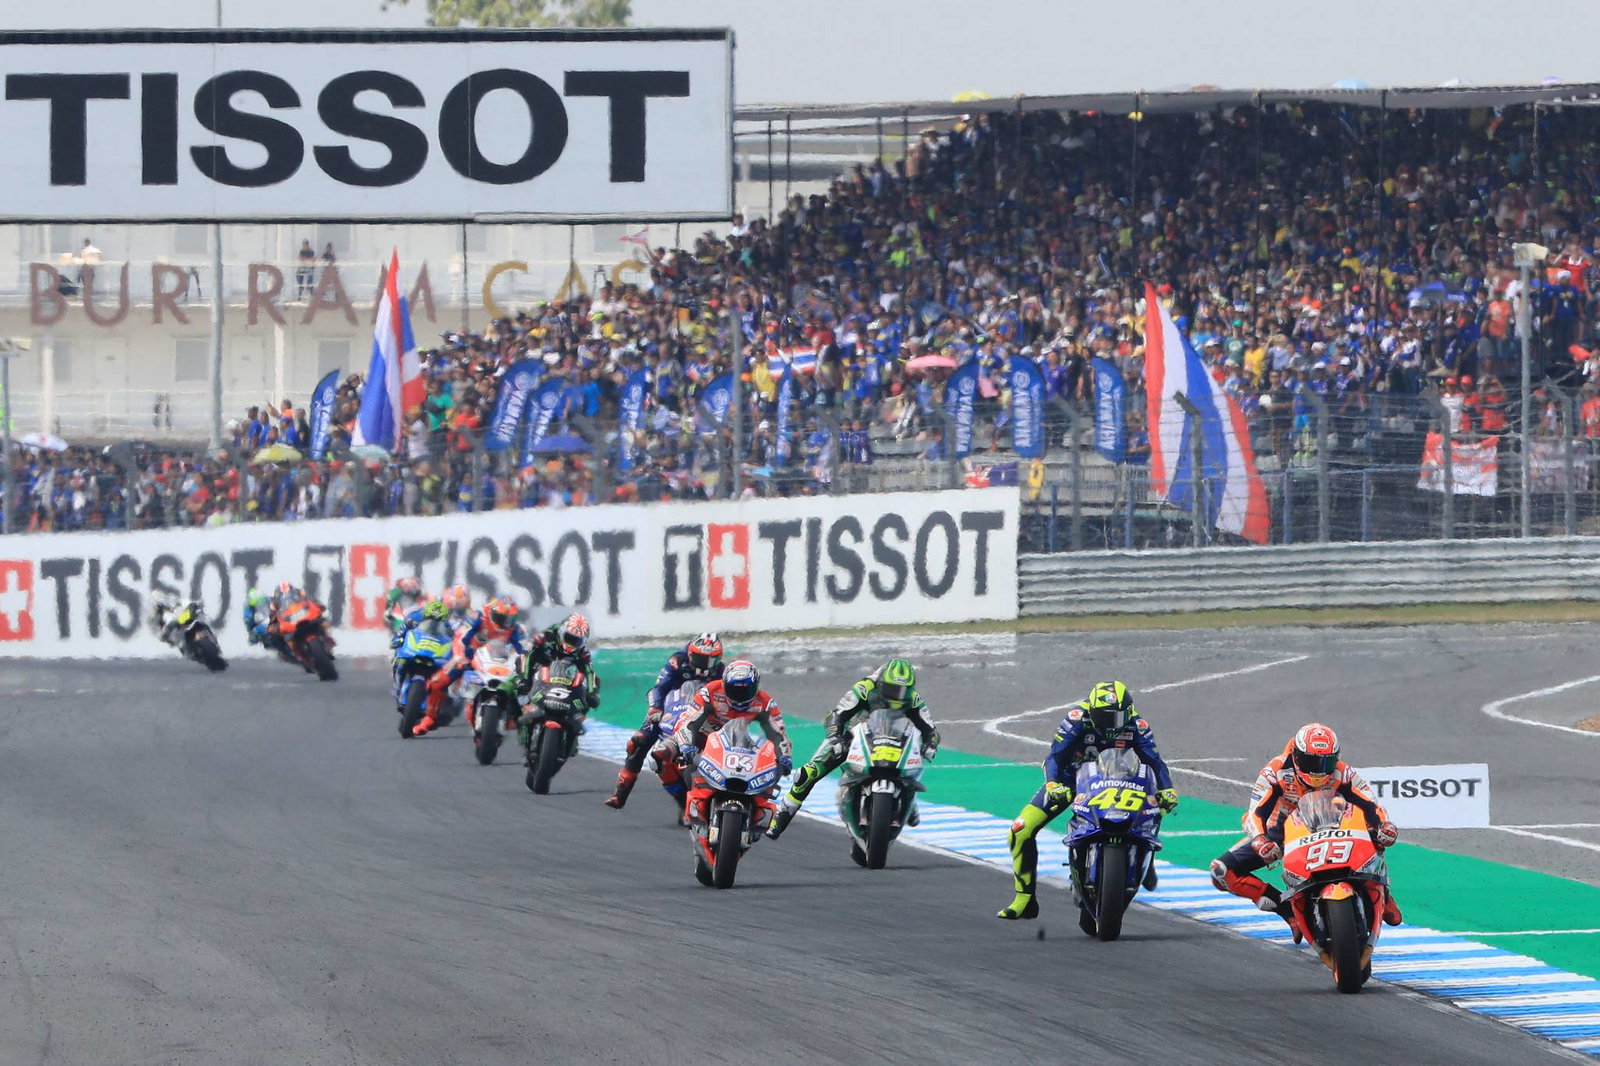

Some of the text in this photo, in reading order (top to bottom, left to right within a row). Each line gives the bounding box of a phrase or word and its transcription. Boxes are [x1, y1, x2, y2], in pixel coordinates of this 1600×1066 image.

[4, 69, 690, 187] TISSOT
[30, 260, 437, 327] BURRAM
[398, 530, 635, 616] TISSOT
[758, 511, 1004, 606] TISSOT
[40, 548, 275, 639] TISSOT
[546, 687, 572, 699] 5
[726, 754, 753, 772] 04
[1088, 788, 1146, 811] 46
[1370, 778, 1481, 798] TISSOT
[1299, 829, 1353, 846] REPSOL
[1306, 841, 1354, 871] 93
